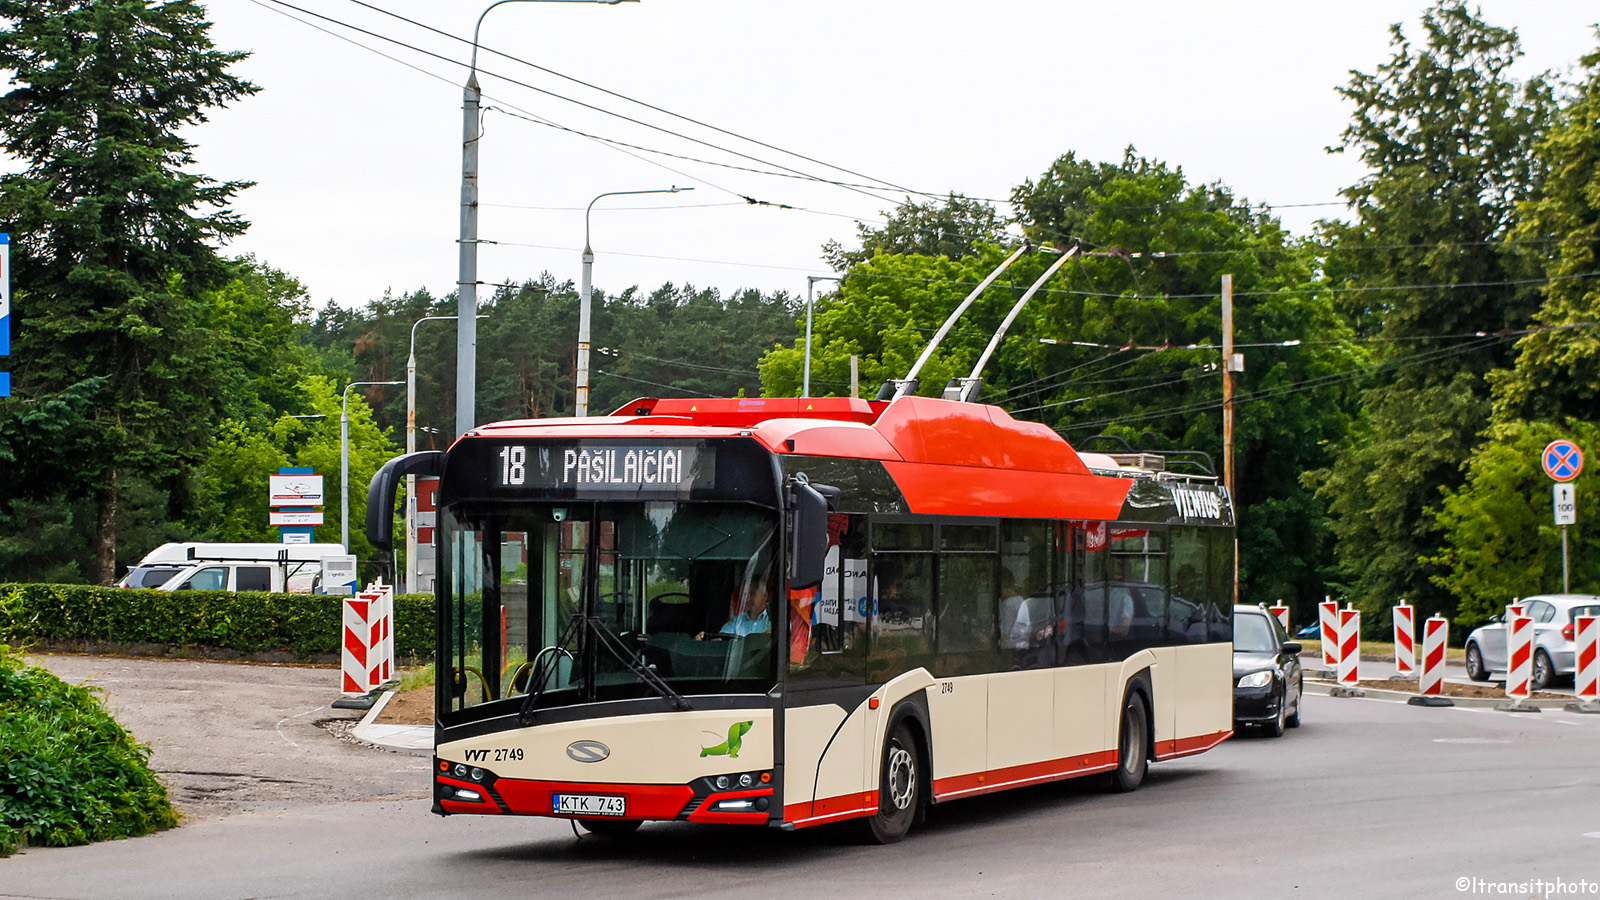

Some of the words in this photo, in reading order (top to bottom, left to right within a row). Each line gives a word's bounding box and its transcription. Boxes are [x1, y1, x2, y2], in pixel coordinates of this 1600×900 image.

[499, 446, 526, 485] 18
[563, 449, 682, 484] PAŠILAIČIAI
[1171, 488, 1220, 519] VILNIUS
[1557, 503, 1573, 512] 100
[494, 748, 524, 762] 2749
[561, 796, 589, 810] KTK
[598, 798, 623, 811] 743
